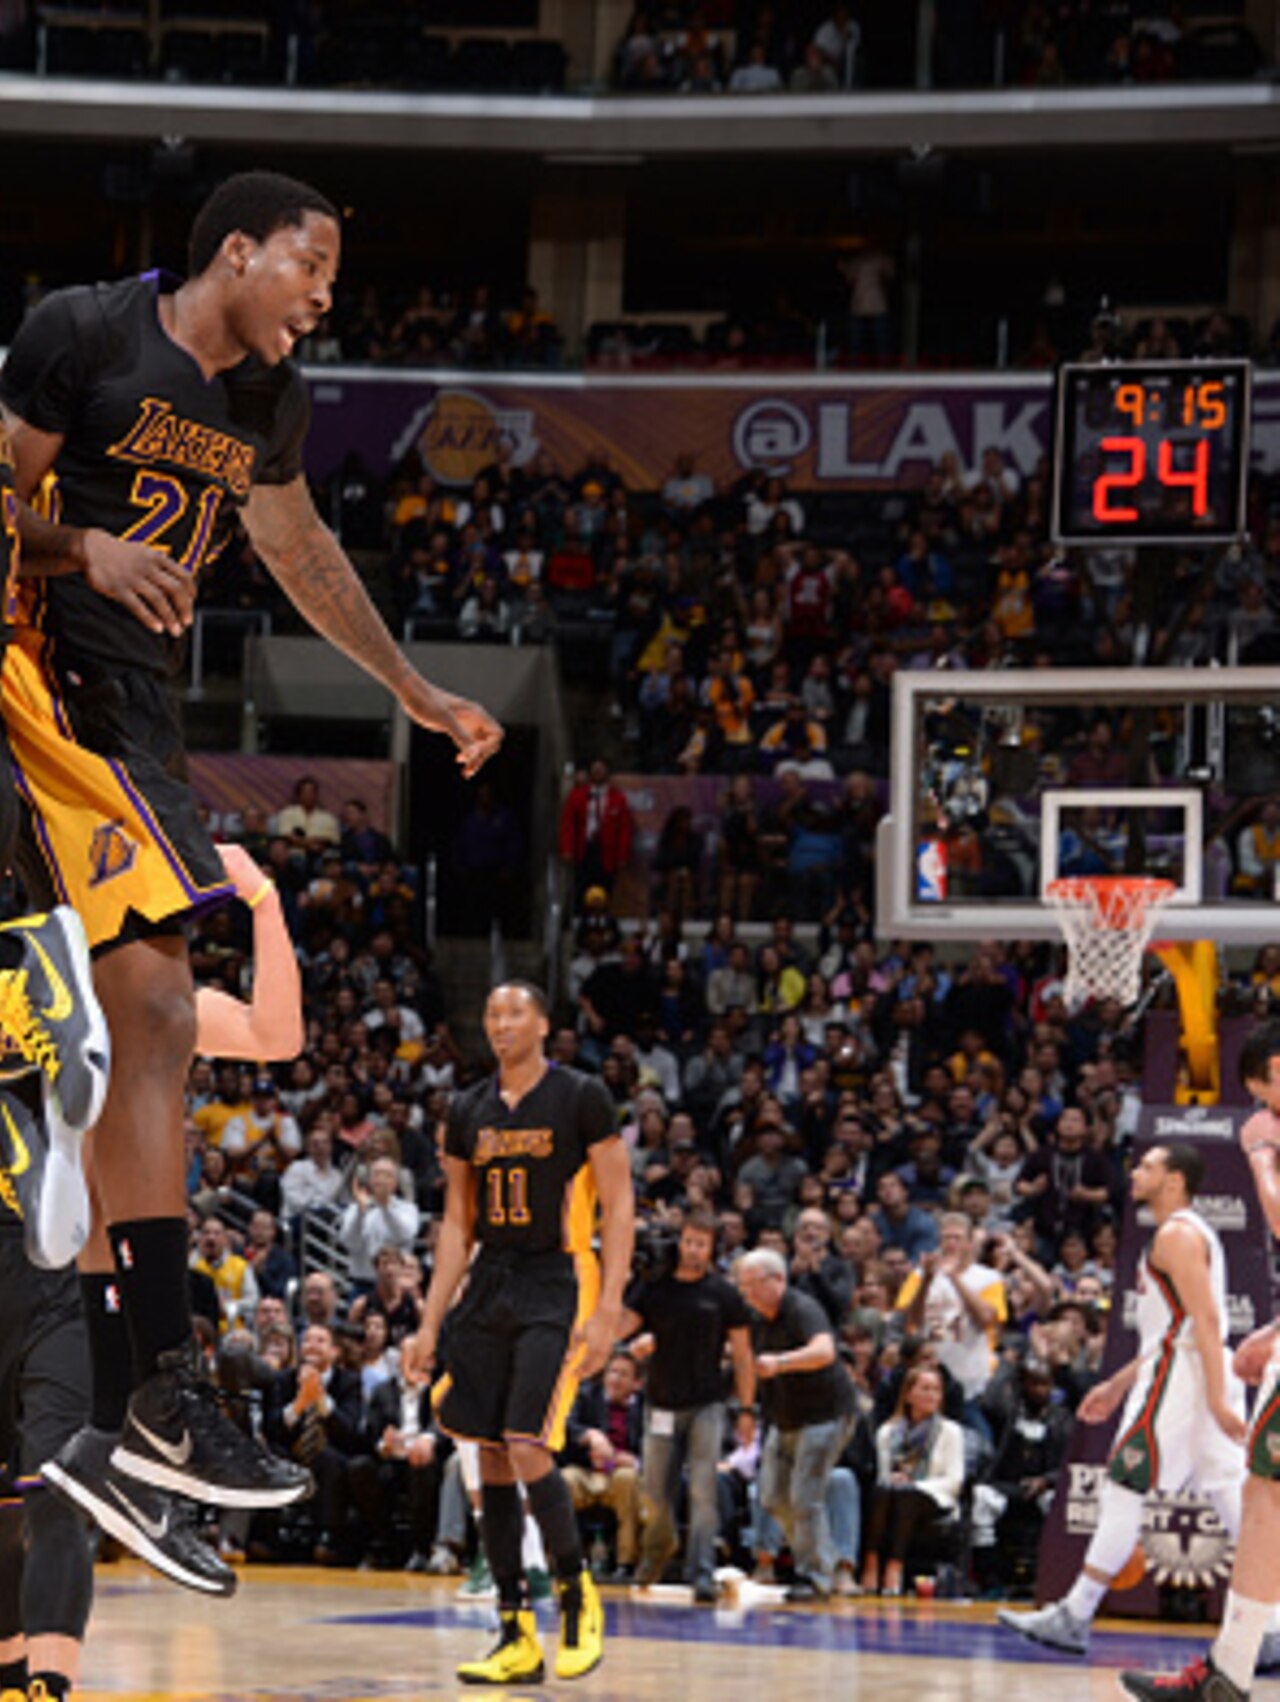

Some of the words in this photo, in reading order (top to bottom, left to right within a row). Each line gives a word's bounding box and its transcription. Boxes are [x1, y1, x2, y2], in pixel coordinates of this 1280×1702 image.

[1115, 381, 1227, 430] 9:15
[1093, 436, 1210, 522] 24
[119, 468, 224, 576] 21
[487, 1167, 532, 1226] 11
